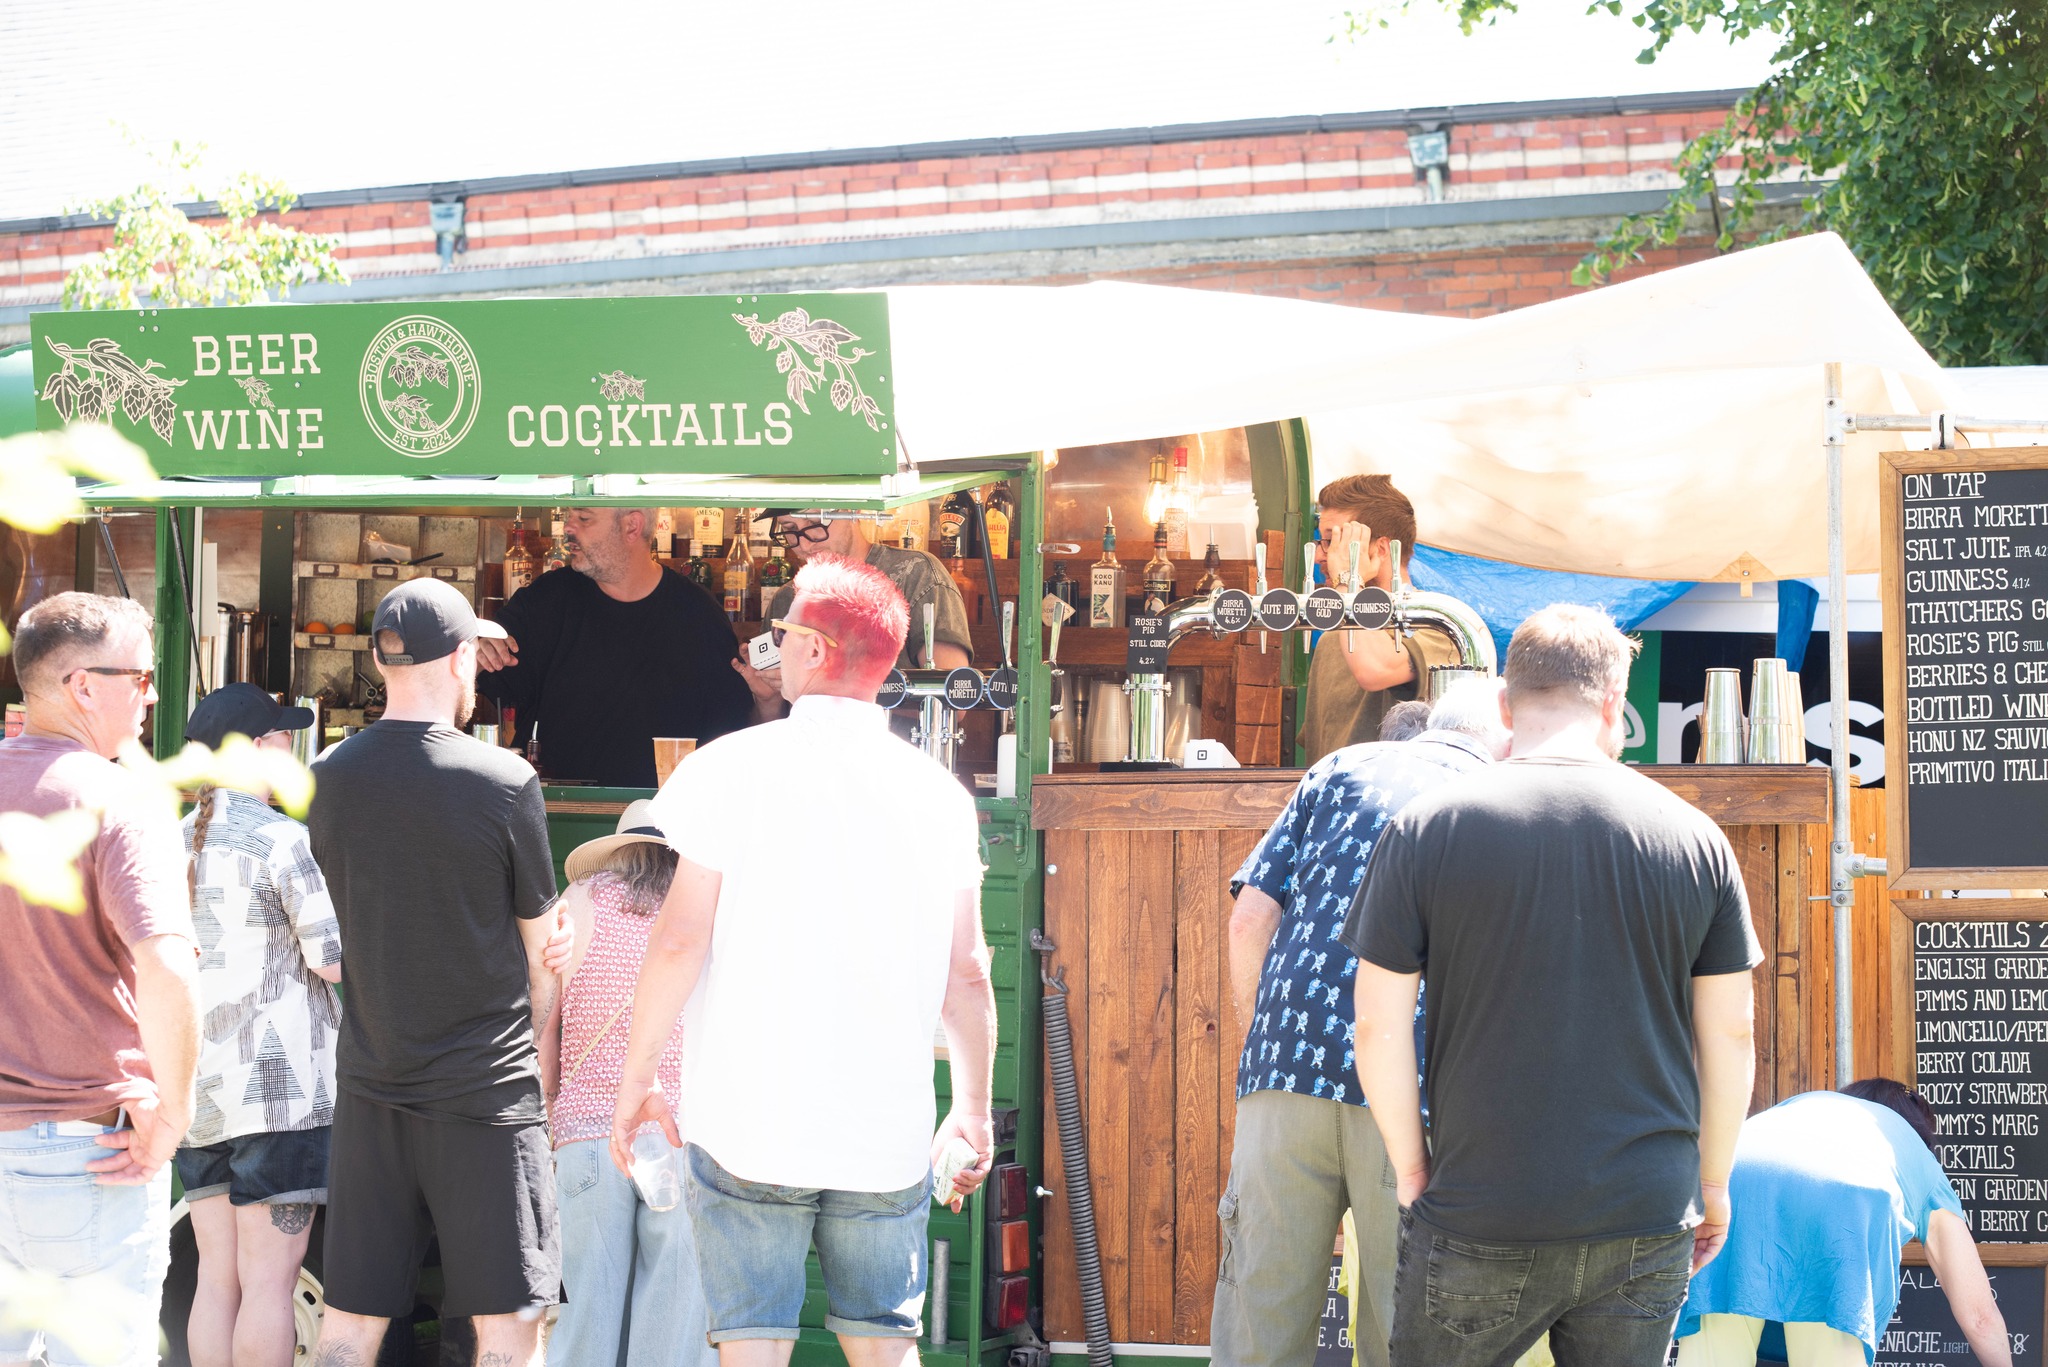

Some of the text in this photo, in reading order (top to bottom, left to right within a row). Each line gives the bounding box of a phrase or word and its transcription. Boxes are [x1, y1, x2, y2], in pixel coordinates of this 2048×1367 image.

[192, 333, 321, 376] BEER
[365, 323, 474, 383] BOSTON & HAWTHORNE
[182, 408, 324, 450] WINE
[507, 402, 793, 448] COCKTAILS
[393, 430, 452, 450] EST 2024
[1905, 472, 1987, 498] ON TAP
[696, 509, 721, 518] AMESON
[1905, 503, 2048, 530] BIRRA MORETT
[1906, 536, 2048, 561] SALT JUTE IPA 4.2
[1906, 568, 2031, 593] GUINNESS 4.1%
[1217, 607, 1247, 616] MORETTI
[1222, 599, 1244, 608] BIRRA
[1261, 604, 1296, 615] JUTE IPA
[1309, 597, 1343, 609] THATCHERS
[1316, 609, 1332, 618] GOLD
[1353, 602, 1390, 614] GUINNESS
[1907, 598, 2048, 624] THATCHERS G
[1135, 618, 1163, 626] ROSIE'S
[1149, 640, 1167, 648] CIDER
[1907, 631, 1980, 656] ROSIE'S
[1986, 631, 2020, 653] PIG
[2022, 640, 2045, 652] STILL
[953, 680, 972, 689] BIRRA
[1907, 663, 1988, 688] BERRIES
[948, 688, 977, 699] MORETTI
[1907, 695, 1993, 722] BOTTLED
[1908, 729, 1956, 753] HONU
[1961, 729, 1987, 751] NZ
[1908, 760, 1995, 785] PRIMITIVO
[1915, 921, 2030, 949] COCKTAILS
[1915, 958, 2048, 981] ENGLISH GARDE
[1915, 989, 1968, 1012] PIMMS
[1973, 989, 2006, 1011] AND
[1915, 1020, 2048, 1043] LIMONCELLO/APE
[1916, 1051, 2032, 1074] BERRY COLADA
[1932, 1113, 2039, 1136] OMMY'S MARG
[1934, 1144, 2015, 1170] OCKTAILS
[1984, 1179, 2048, 1201] GARDEN
[1981, 1210, 2030, 1232] BERRY
[1943, 1342, 1970, 1354] LIGHT
